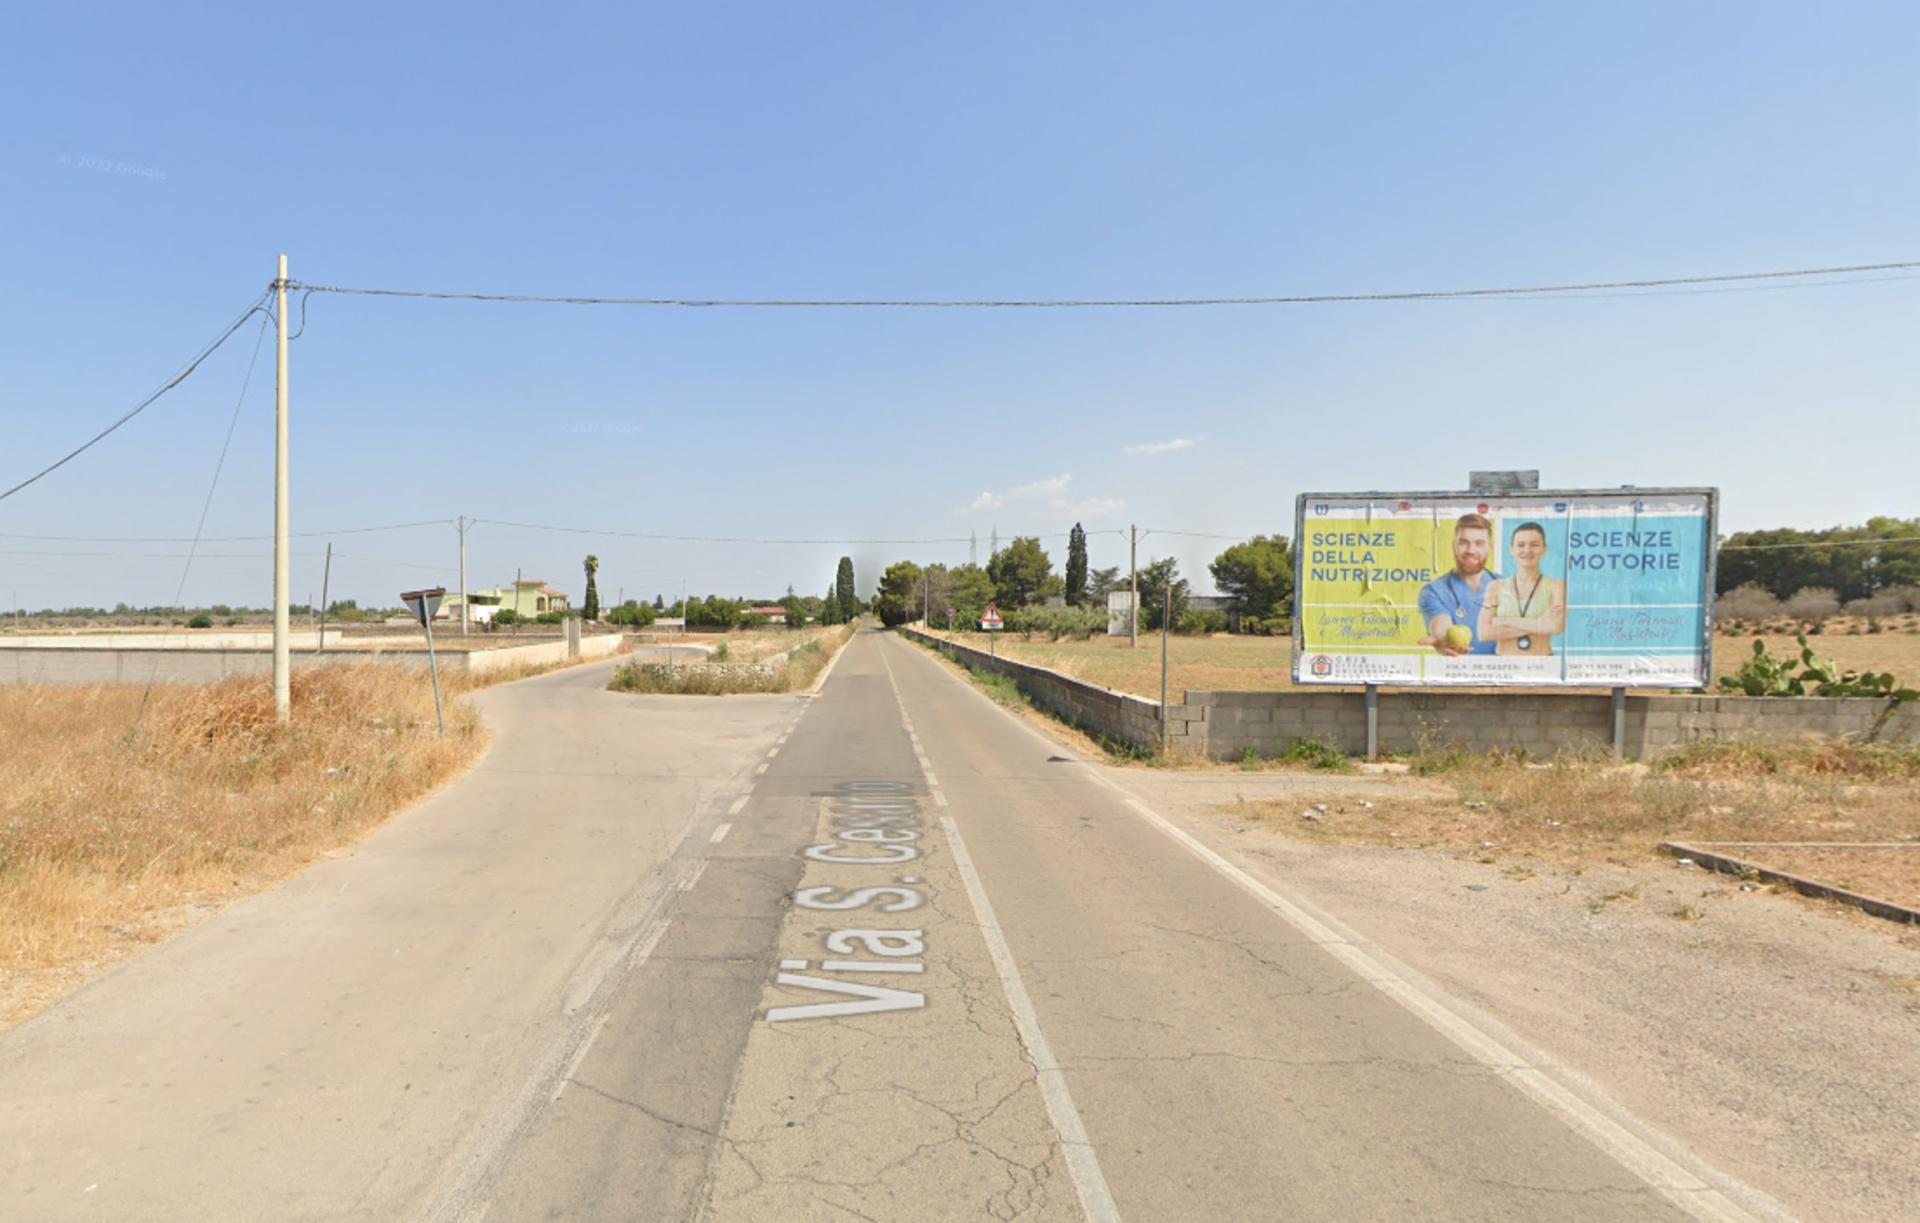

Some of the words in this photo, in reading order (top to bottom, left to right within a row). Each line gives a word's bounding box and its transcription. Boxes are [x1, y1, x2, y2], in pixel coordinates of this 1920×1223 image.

[1312, 532, 1395, 547] SCIENZE
[1569, 531, 1673, 548] SCIENZE
[1312, 550, 1375, 564] DELLA
[1568, 552, 1680, 570] MOTORIE
[1311, 567, 1431, 582] NUTRIZIONE
